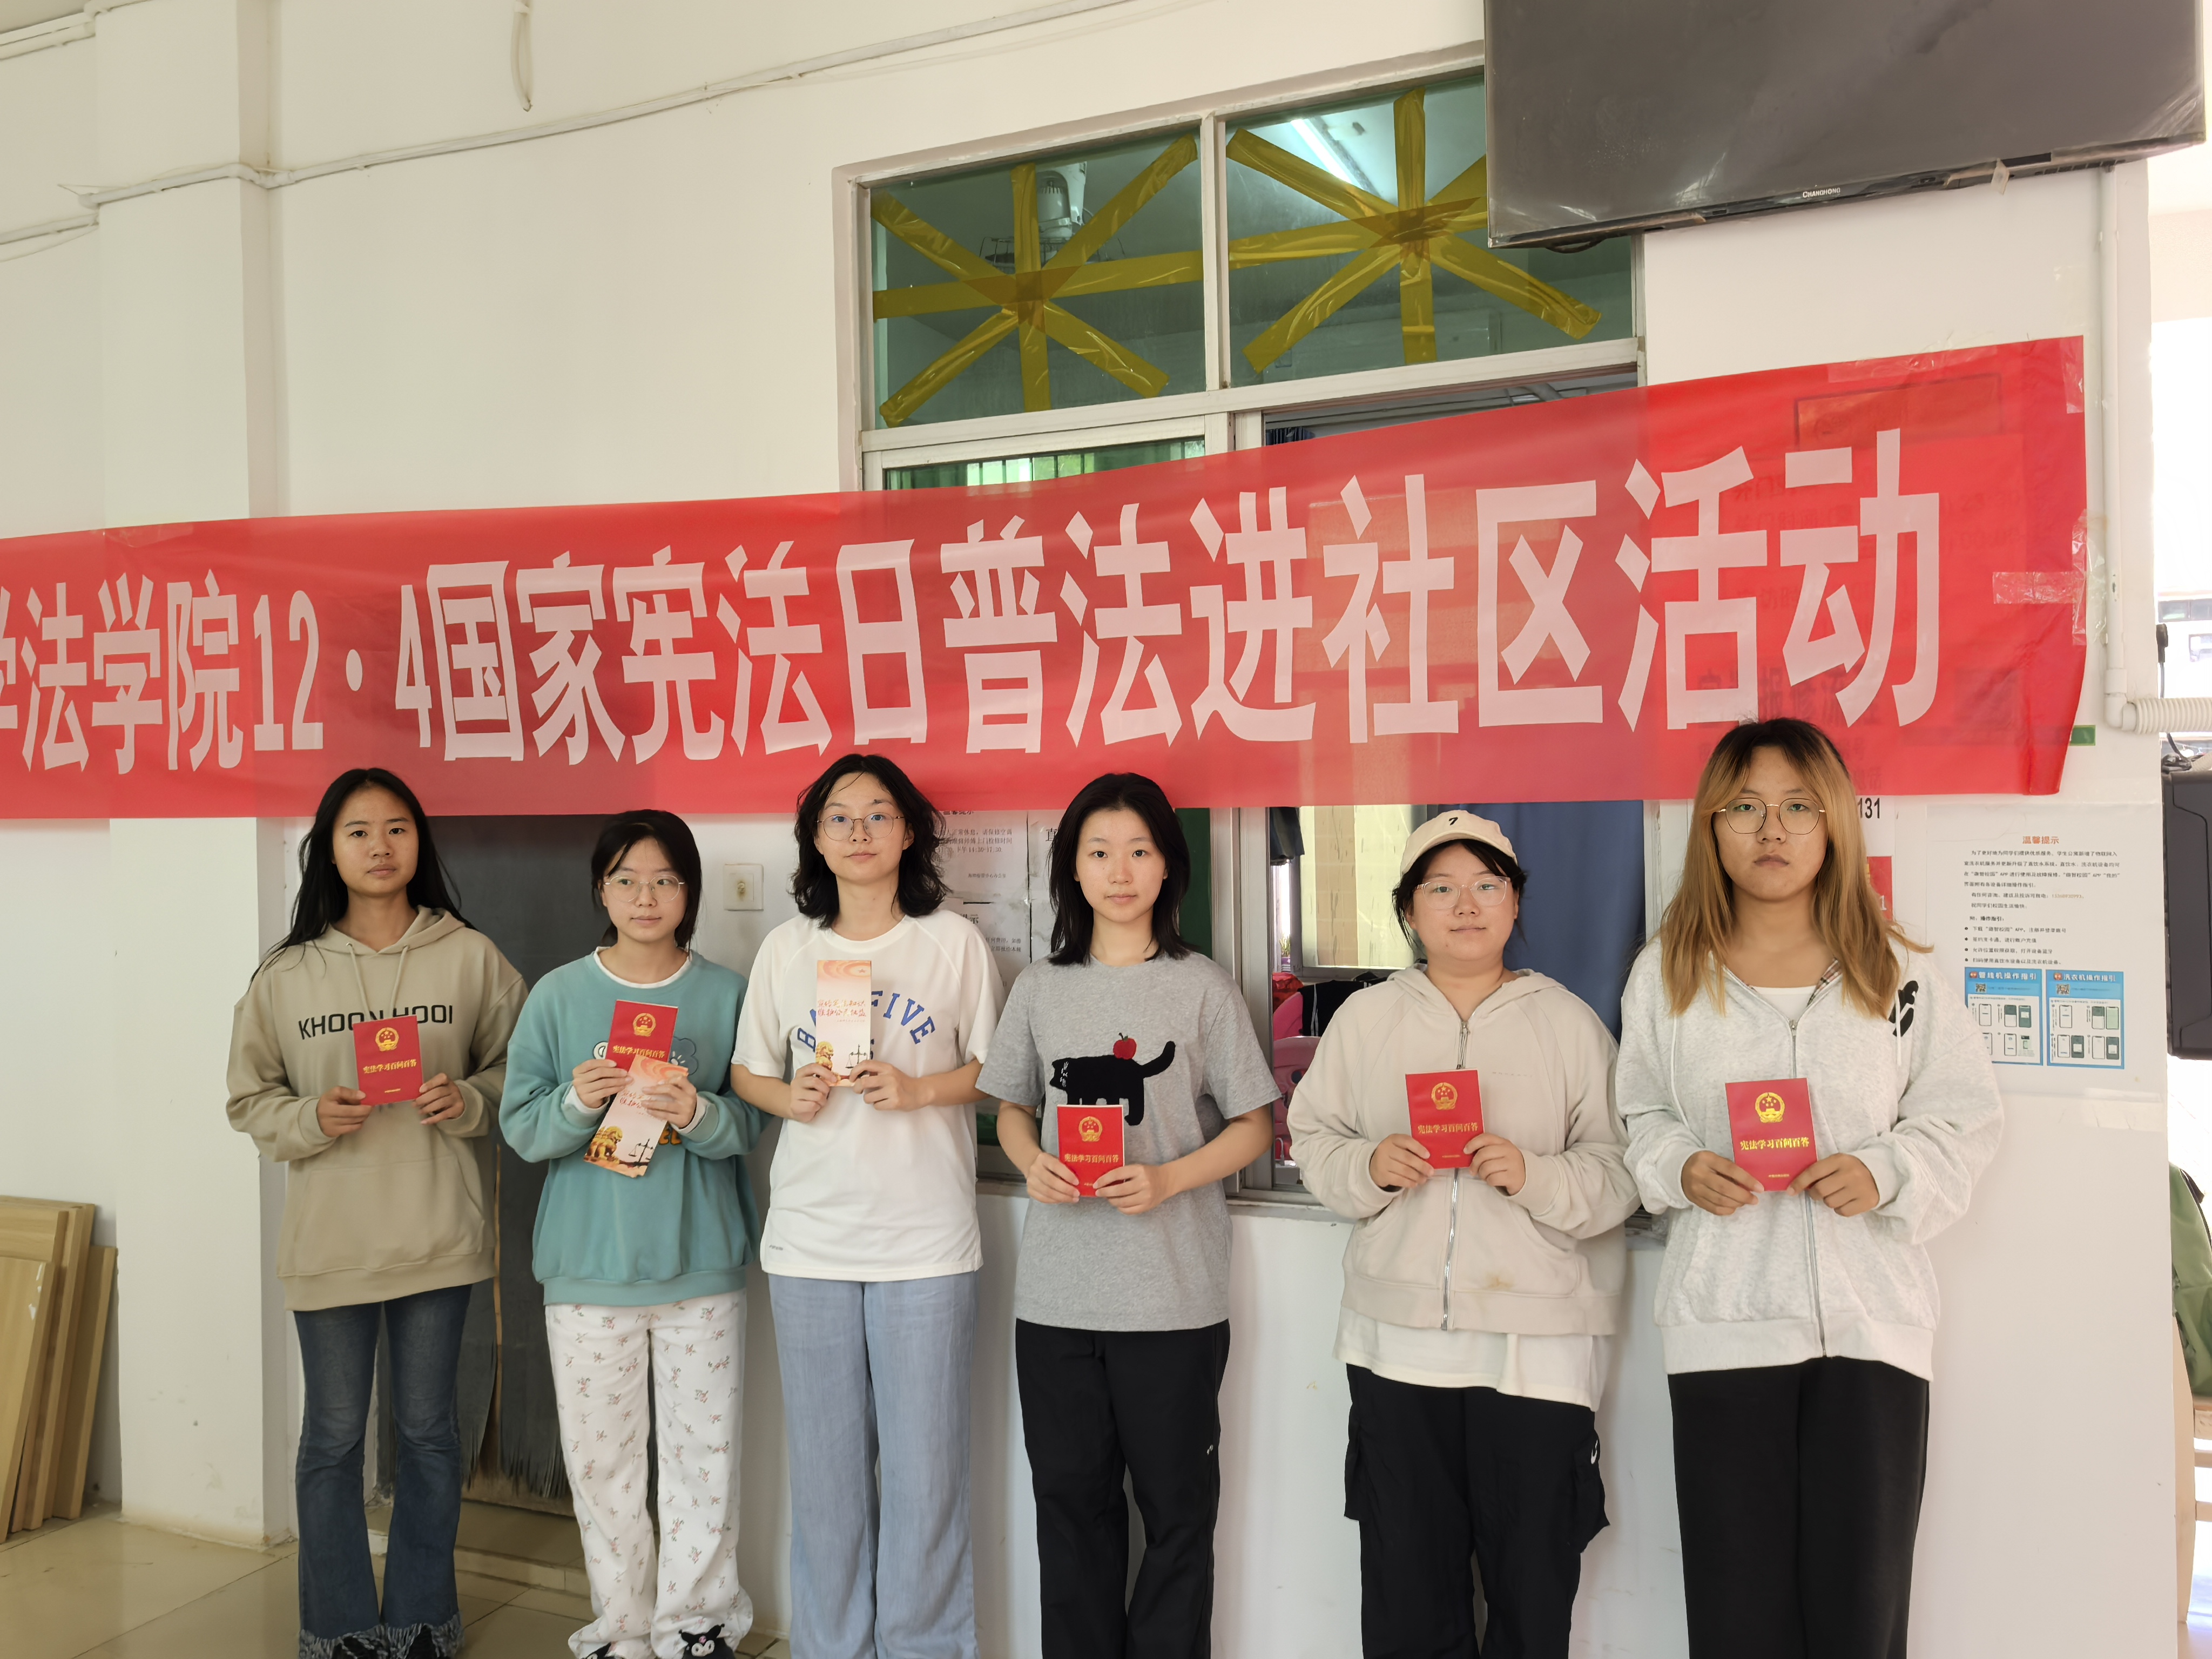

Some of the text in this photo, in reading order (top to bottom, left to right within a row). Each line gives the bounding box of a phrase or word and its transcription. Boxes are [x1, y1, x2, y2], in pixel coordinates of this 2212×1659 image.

[1803, 187, 1840, 198] CHANGHONG
[0, 428, 1940, 775] 法学院12·4国家宪法日普法进社区活动
[2022, 836, 2060, 845] 温馨提示
[1418, 1122, 1478, 1134] 宪法学习百问百答
[1740, 1137, 1810, 1151] 宪法学习百问百答
